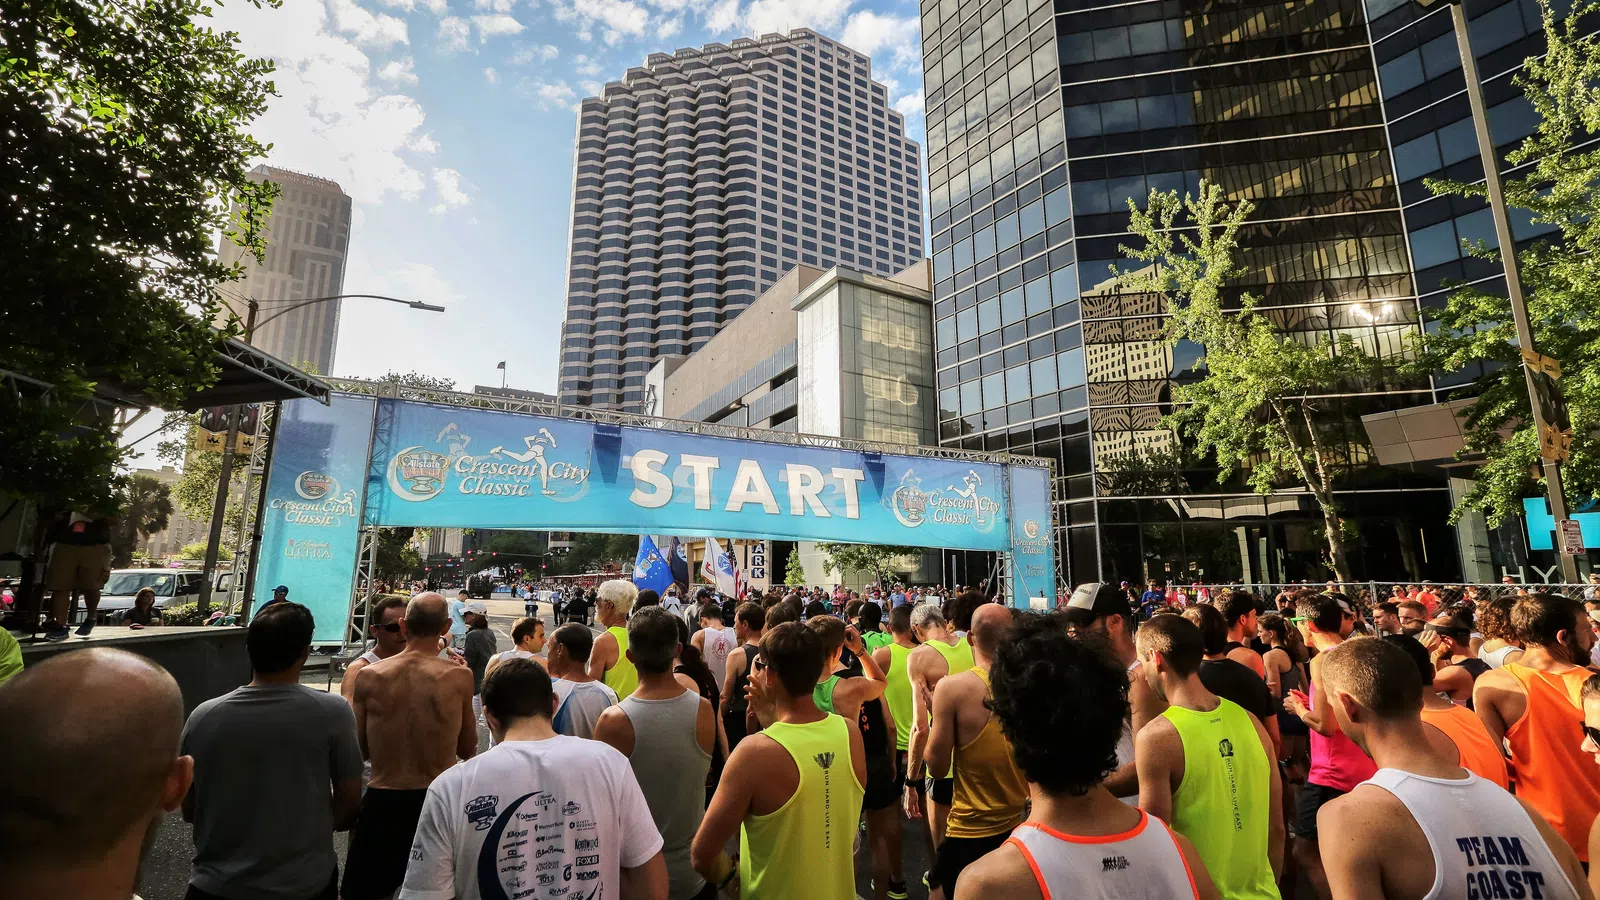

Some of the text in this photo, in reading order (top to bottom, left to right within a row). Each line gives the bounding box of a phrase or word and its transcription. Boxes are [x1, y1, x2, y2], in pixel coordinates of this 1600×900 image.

[406, 459, 440, 469] Allstate
[455, 455, 541, 477] Crescent
[548, 461, 590, 484] City
[459, 475, 530, 497] Classic
[629, 449, 865, 519] START
[271, 498, 349, 516] Crescent City
[929, 492, 974, 509] Crescent
[980, 496, 1000, 515] City
[284, 510, 334, 526] Classic
[934, 508, 971, 525] Classic
[285, 548, 332, 559] ULTRA
[753, 543, 764, 578] ARK
[1456, 836, 1530, 866] TEAM
[1466, 870, 1545, 900] COAST
